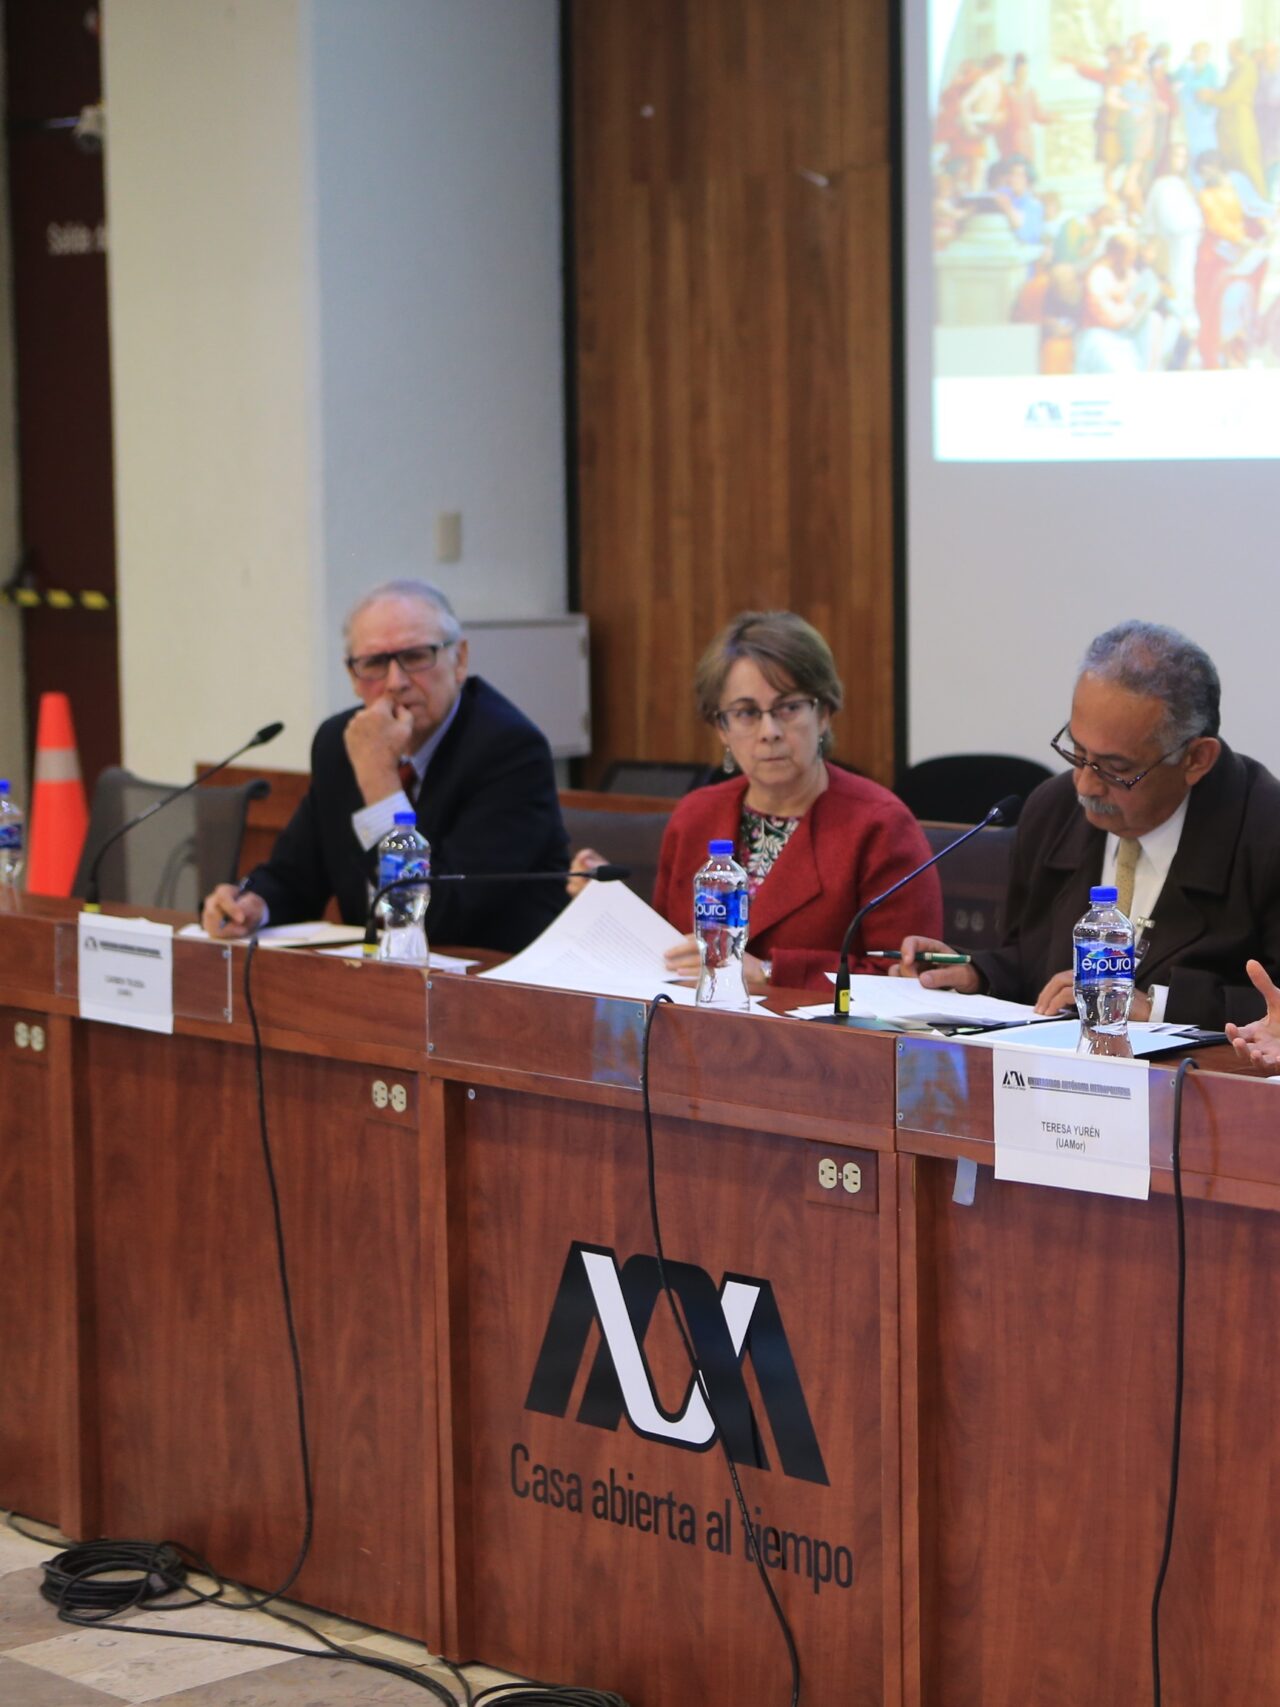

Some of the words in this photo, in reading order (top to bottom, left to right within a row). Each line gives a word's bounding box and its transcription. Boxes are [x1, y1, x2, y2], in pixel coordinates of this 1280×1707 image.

[1041, 1121, 1072, 1135] TERESA
[1056, 1137, 1086, 1152] (UAMor)
[510, 1443, 583, 1514] Casa
[591, 1467, 697, 1546] abierta
[706, 1498, 732, 1556] al
[741, 1506, 854, 1595] tiempo
